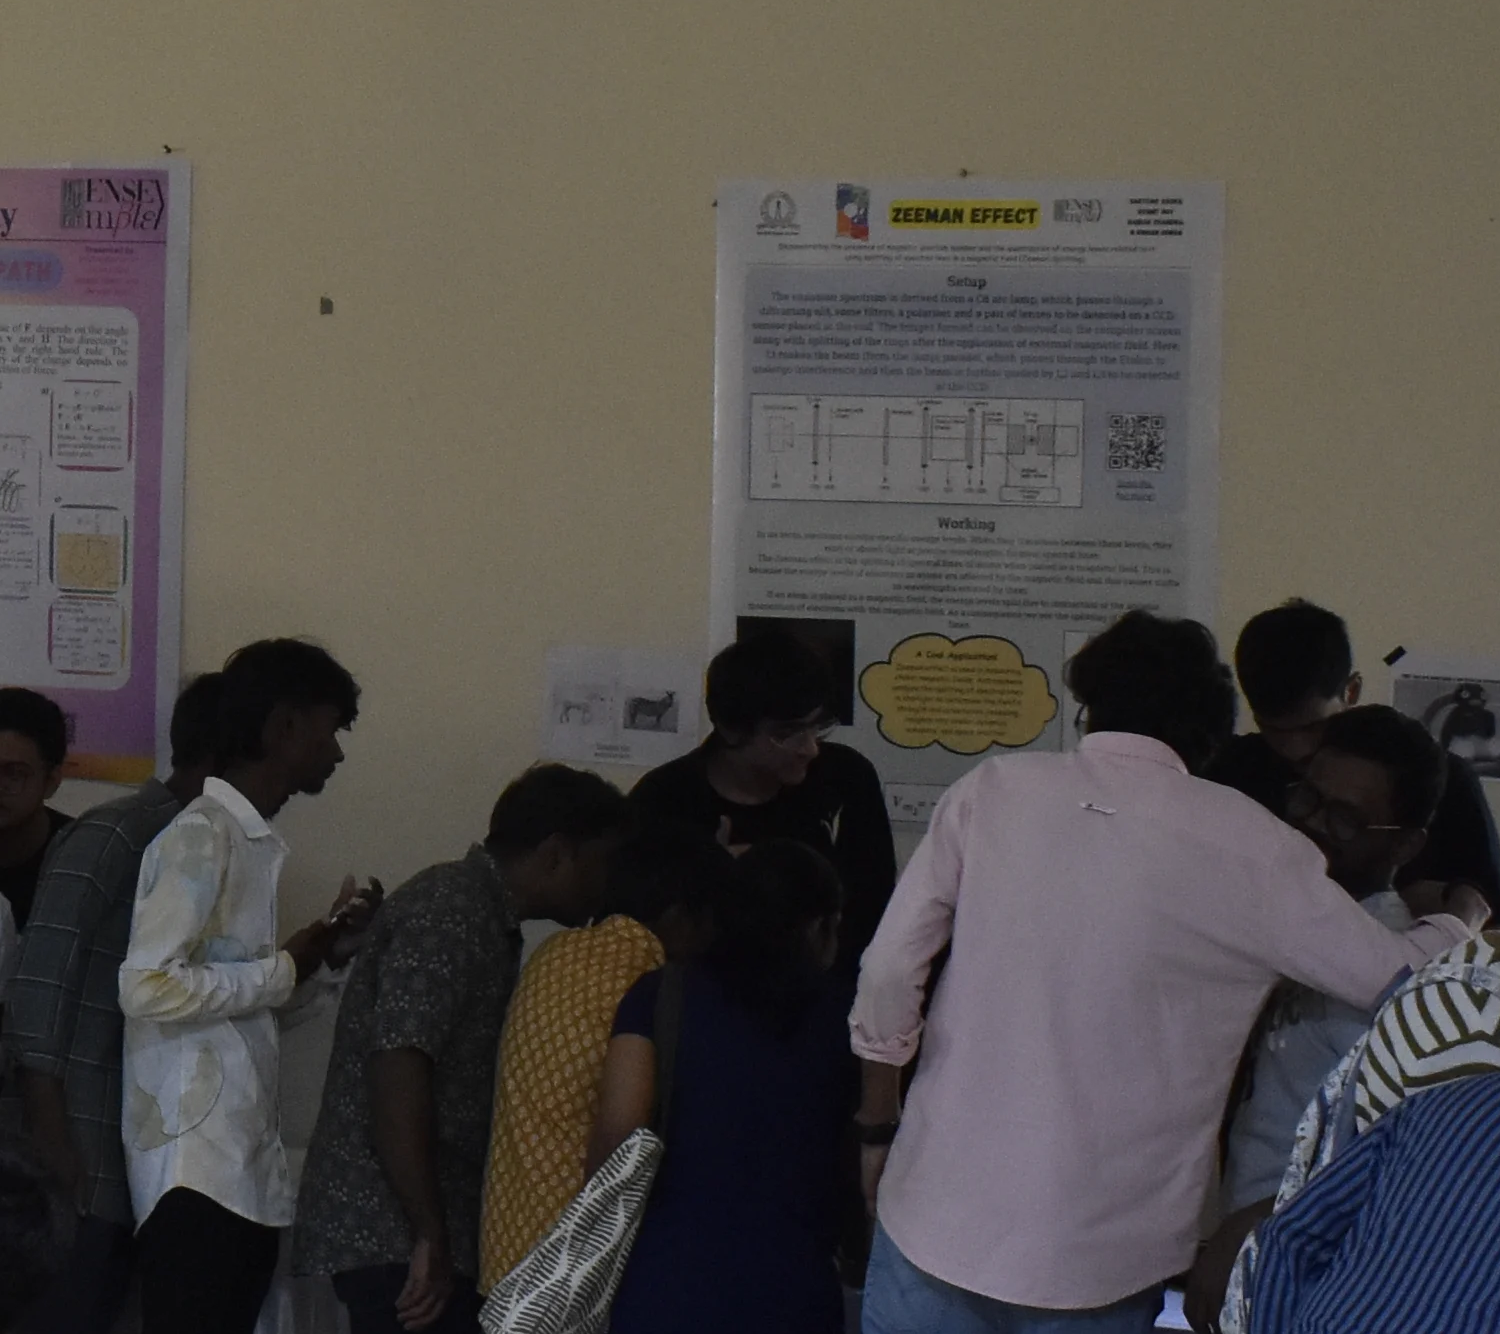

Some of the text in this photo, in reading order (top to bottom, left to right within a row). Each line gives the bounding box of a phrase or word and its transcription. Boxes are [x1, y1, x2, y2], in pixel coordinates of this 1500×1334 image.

[890, 206, 1039, 225] ZEEMAN EFFECT
[946, 274, 988, 291] Setup
[954, 308, 973, 319] and
[35, 324, 72, 335] depends
[74, 326, 86, 334] on
[88, 325, 103, 335] the
[104, 325, 129, 337] angle
[18, 334, 36, 344] and
[57, 335, 75, 345] The
[77, 335, 118, 346] direction
[111, 347, 128, 356] The
[24, 354, 40, 364] the
[75, 356, 113, 367] depends
[937, 516, 997, 534] Working
